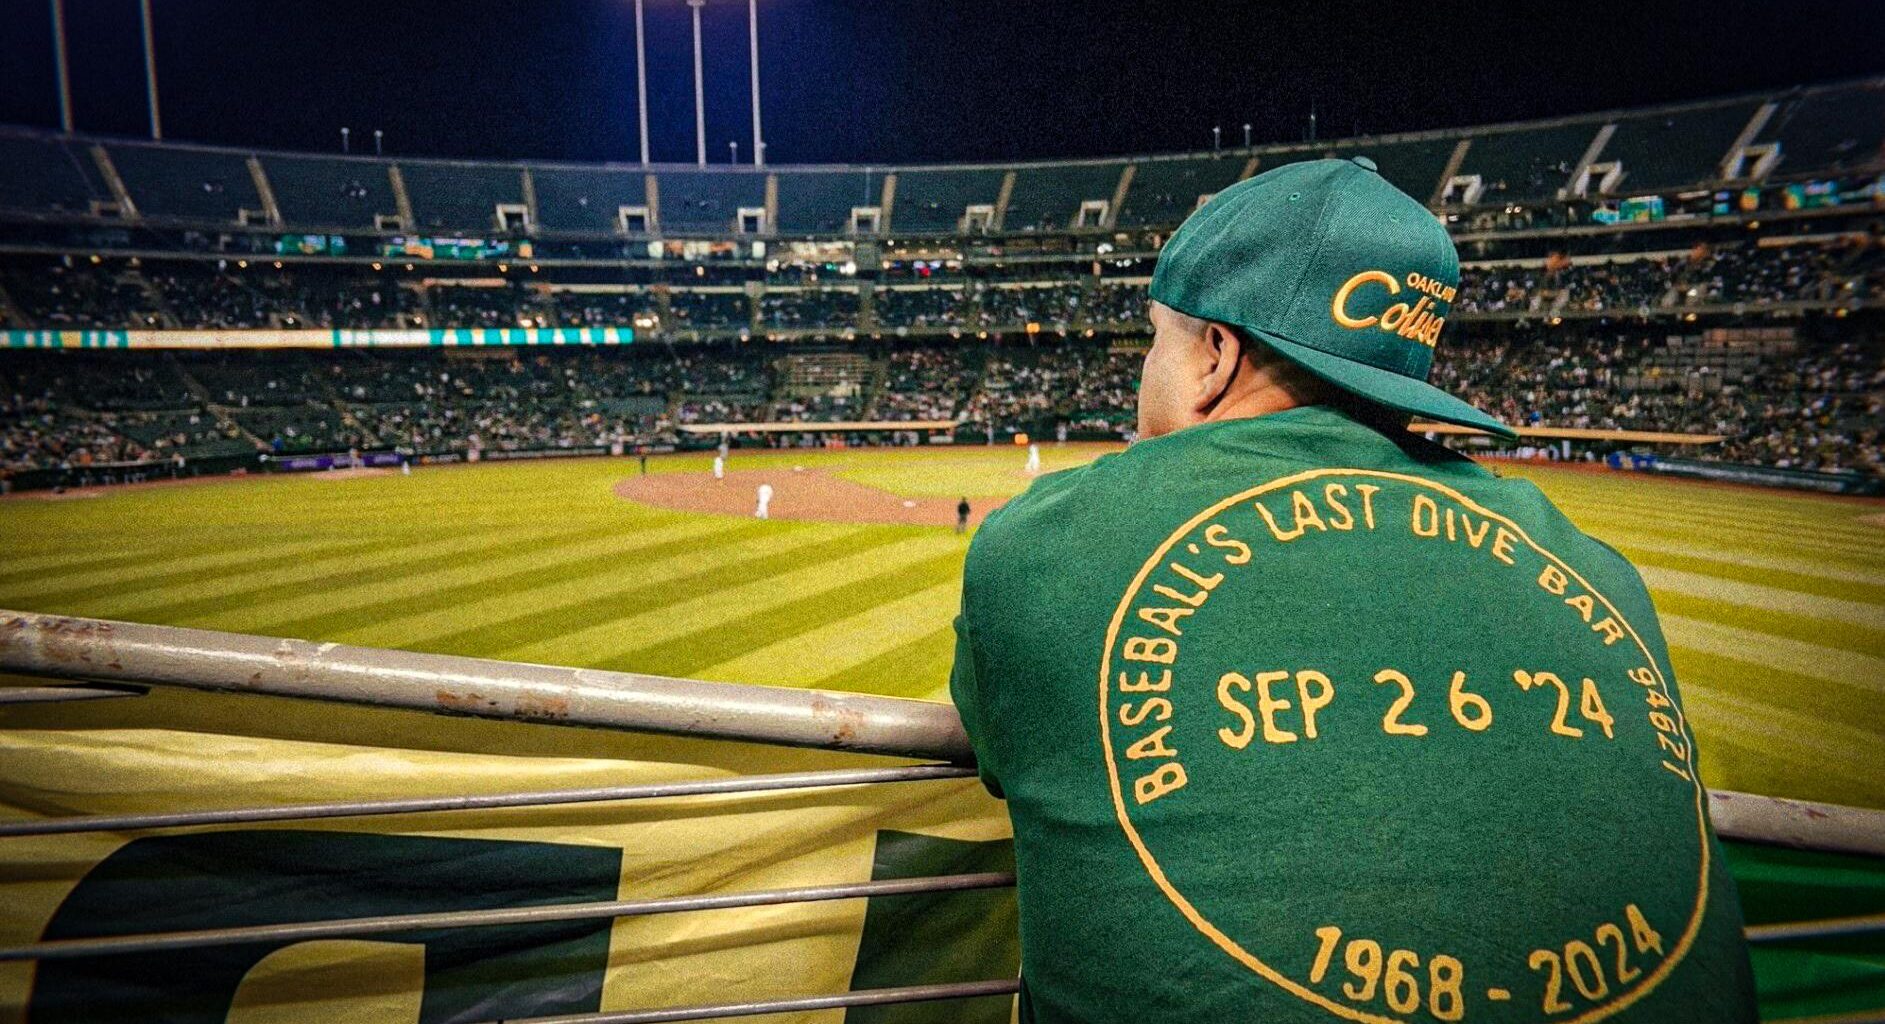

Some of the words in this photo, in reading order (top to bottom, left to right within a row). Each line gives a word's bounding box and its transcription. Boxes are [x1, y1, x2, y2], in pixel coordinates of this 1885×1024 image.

[1118, 523, 1252, 805] BASEBALL'S
[1255, 483, 1380, 542] LAST
[1410, 494, 1519, 566] DIVE
[1536, 565, 1625, 647] BAR
[1216, 669, 1336, 750] SEP
[1512, 669, 1615, 739] '24
[1309, 925, 1465, 1021] 1968
[1528, 903, 1664, 1015] 2024
